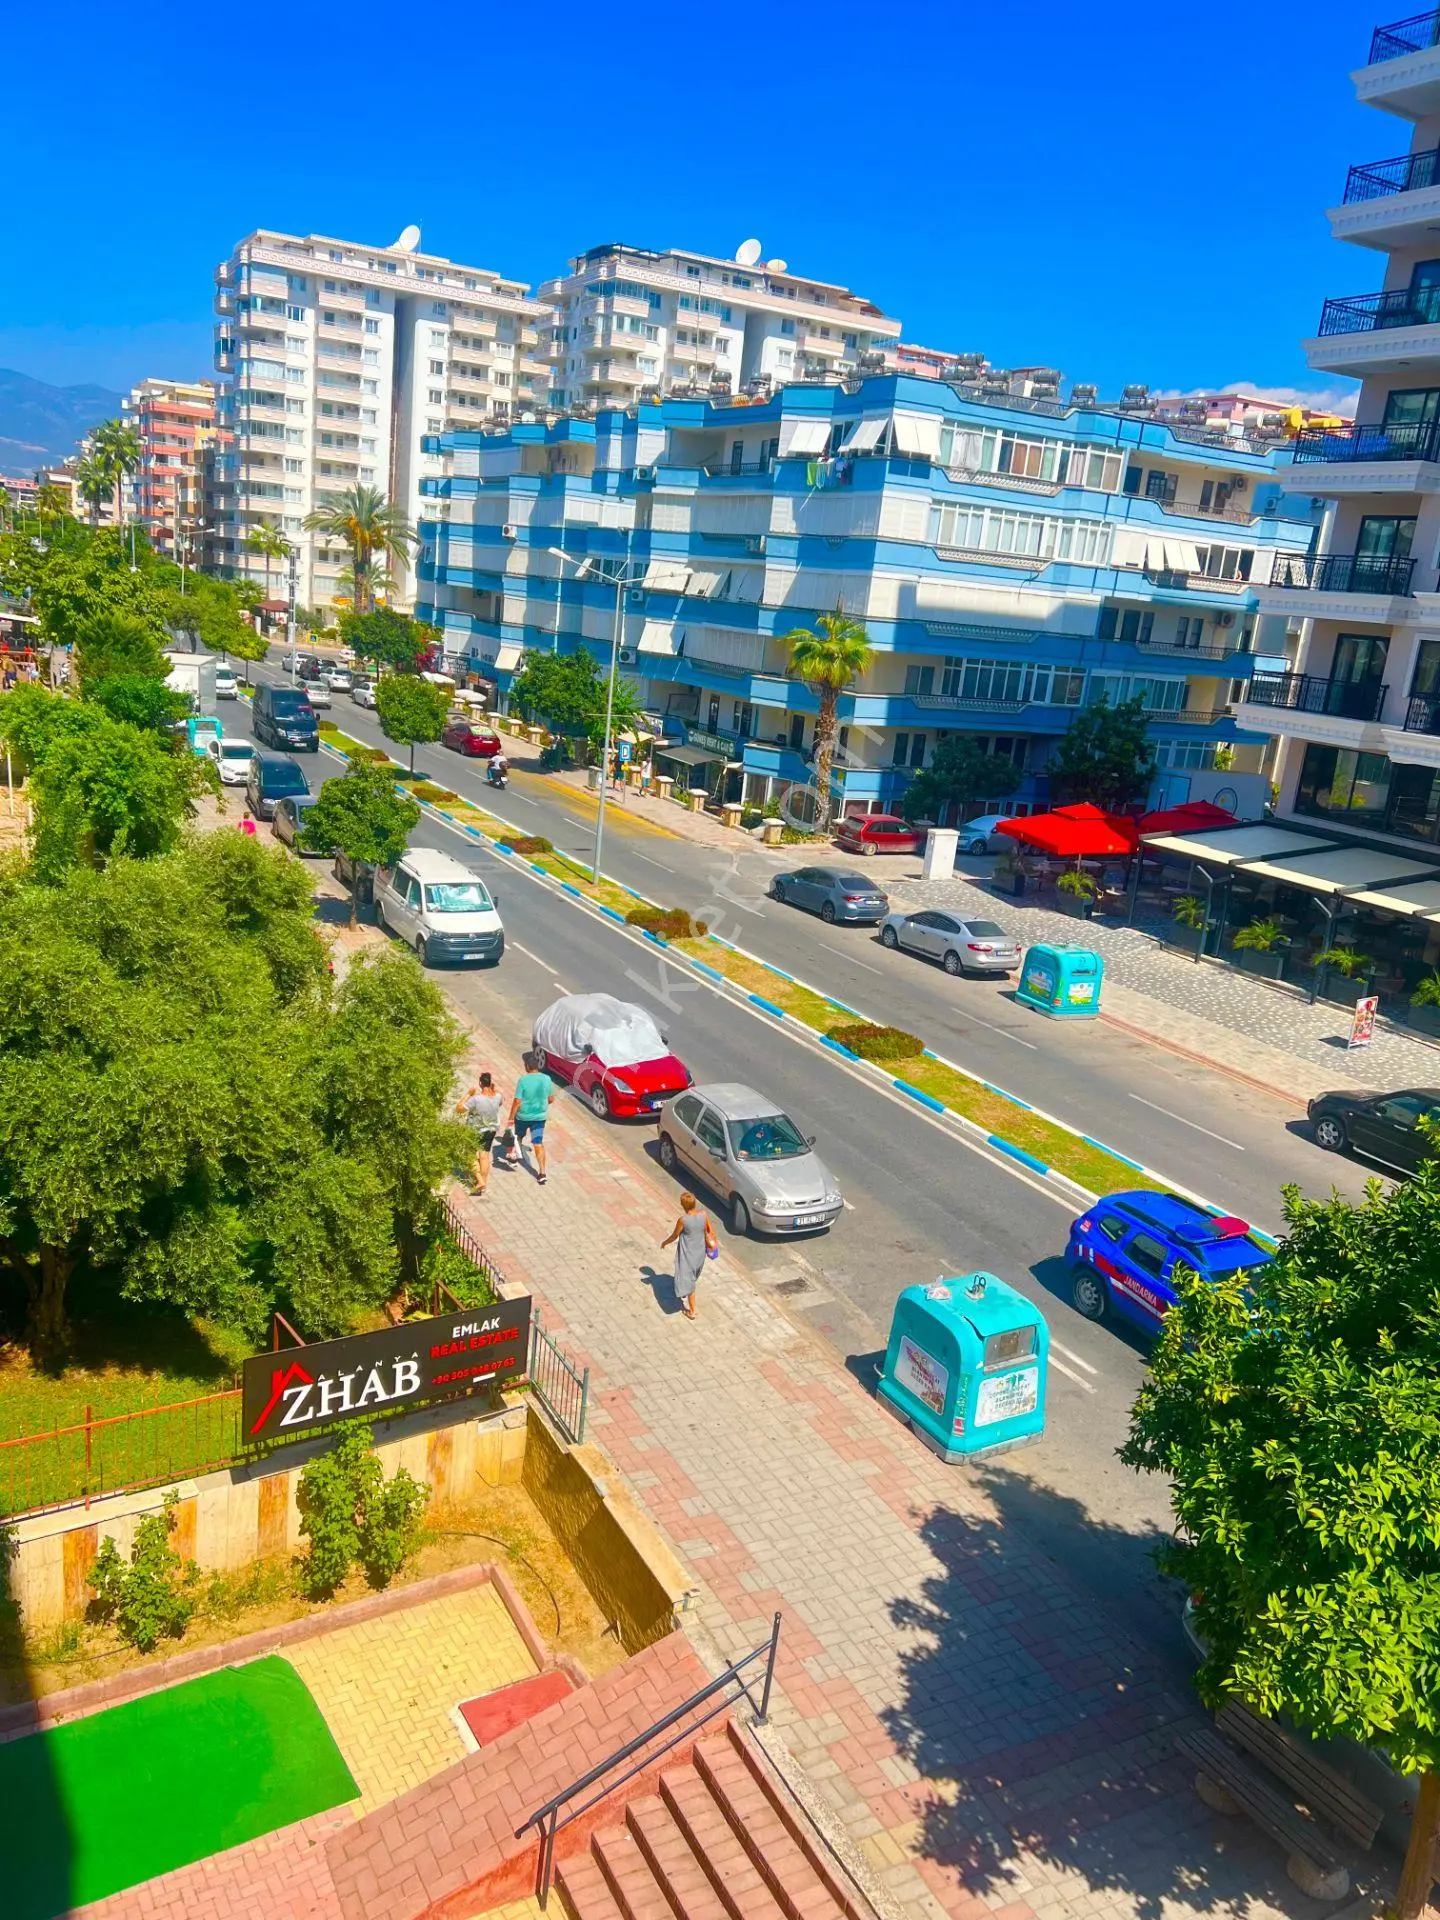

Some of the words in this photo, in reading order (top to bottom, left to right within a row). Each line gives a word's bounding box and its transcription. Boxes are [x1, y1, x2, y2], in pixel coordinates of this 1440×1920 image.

[1123, 1276, 1157, 1307] JANDARMA
[452, 1316, 500, 1338] EMLAK
[430, 1340, 467, 1359] REAL
[469, 1327, 519, 1350] ESTATE
[317, 1351, 419, 1381] ALANYA
[279, 1360, 421, 1427] ZHAB
